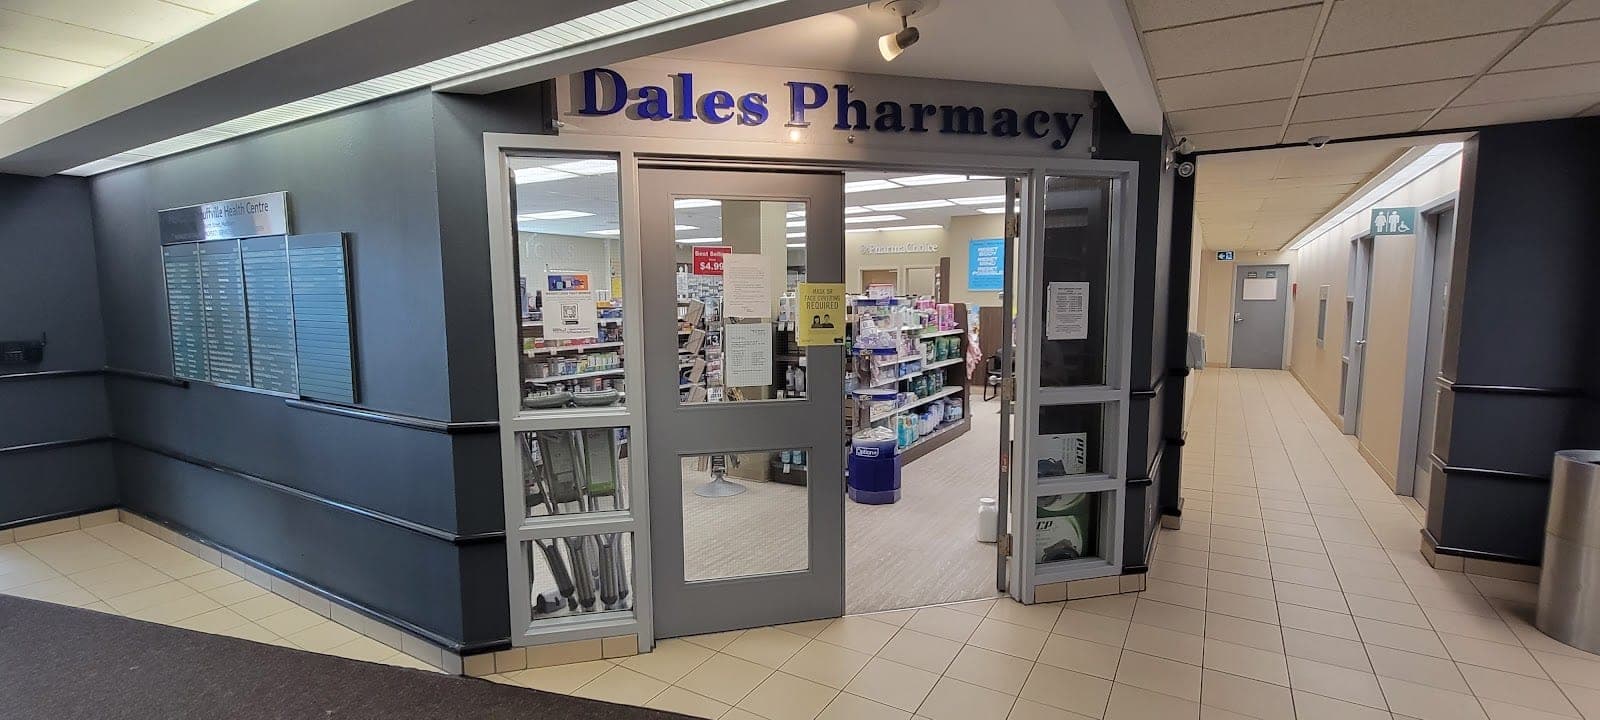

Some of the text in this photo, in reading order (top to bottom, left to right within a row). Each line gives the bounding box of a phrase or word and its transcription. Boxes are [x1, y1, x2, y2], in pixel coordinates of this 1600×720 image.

[575, 67, 1084, 150] Dales Pharmacy
[224, 203, 246, 218] Health
[246, 201, 269, 215] Centre
[700, 261, 723, 271] $4.99
[806, 301, 839, 310] REQUIRED
[1036, 520, 1053, 530] CP
